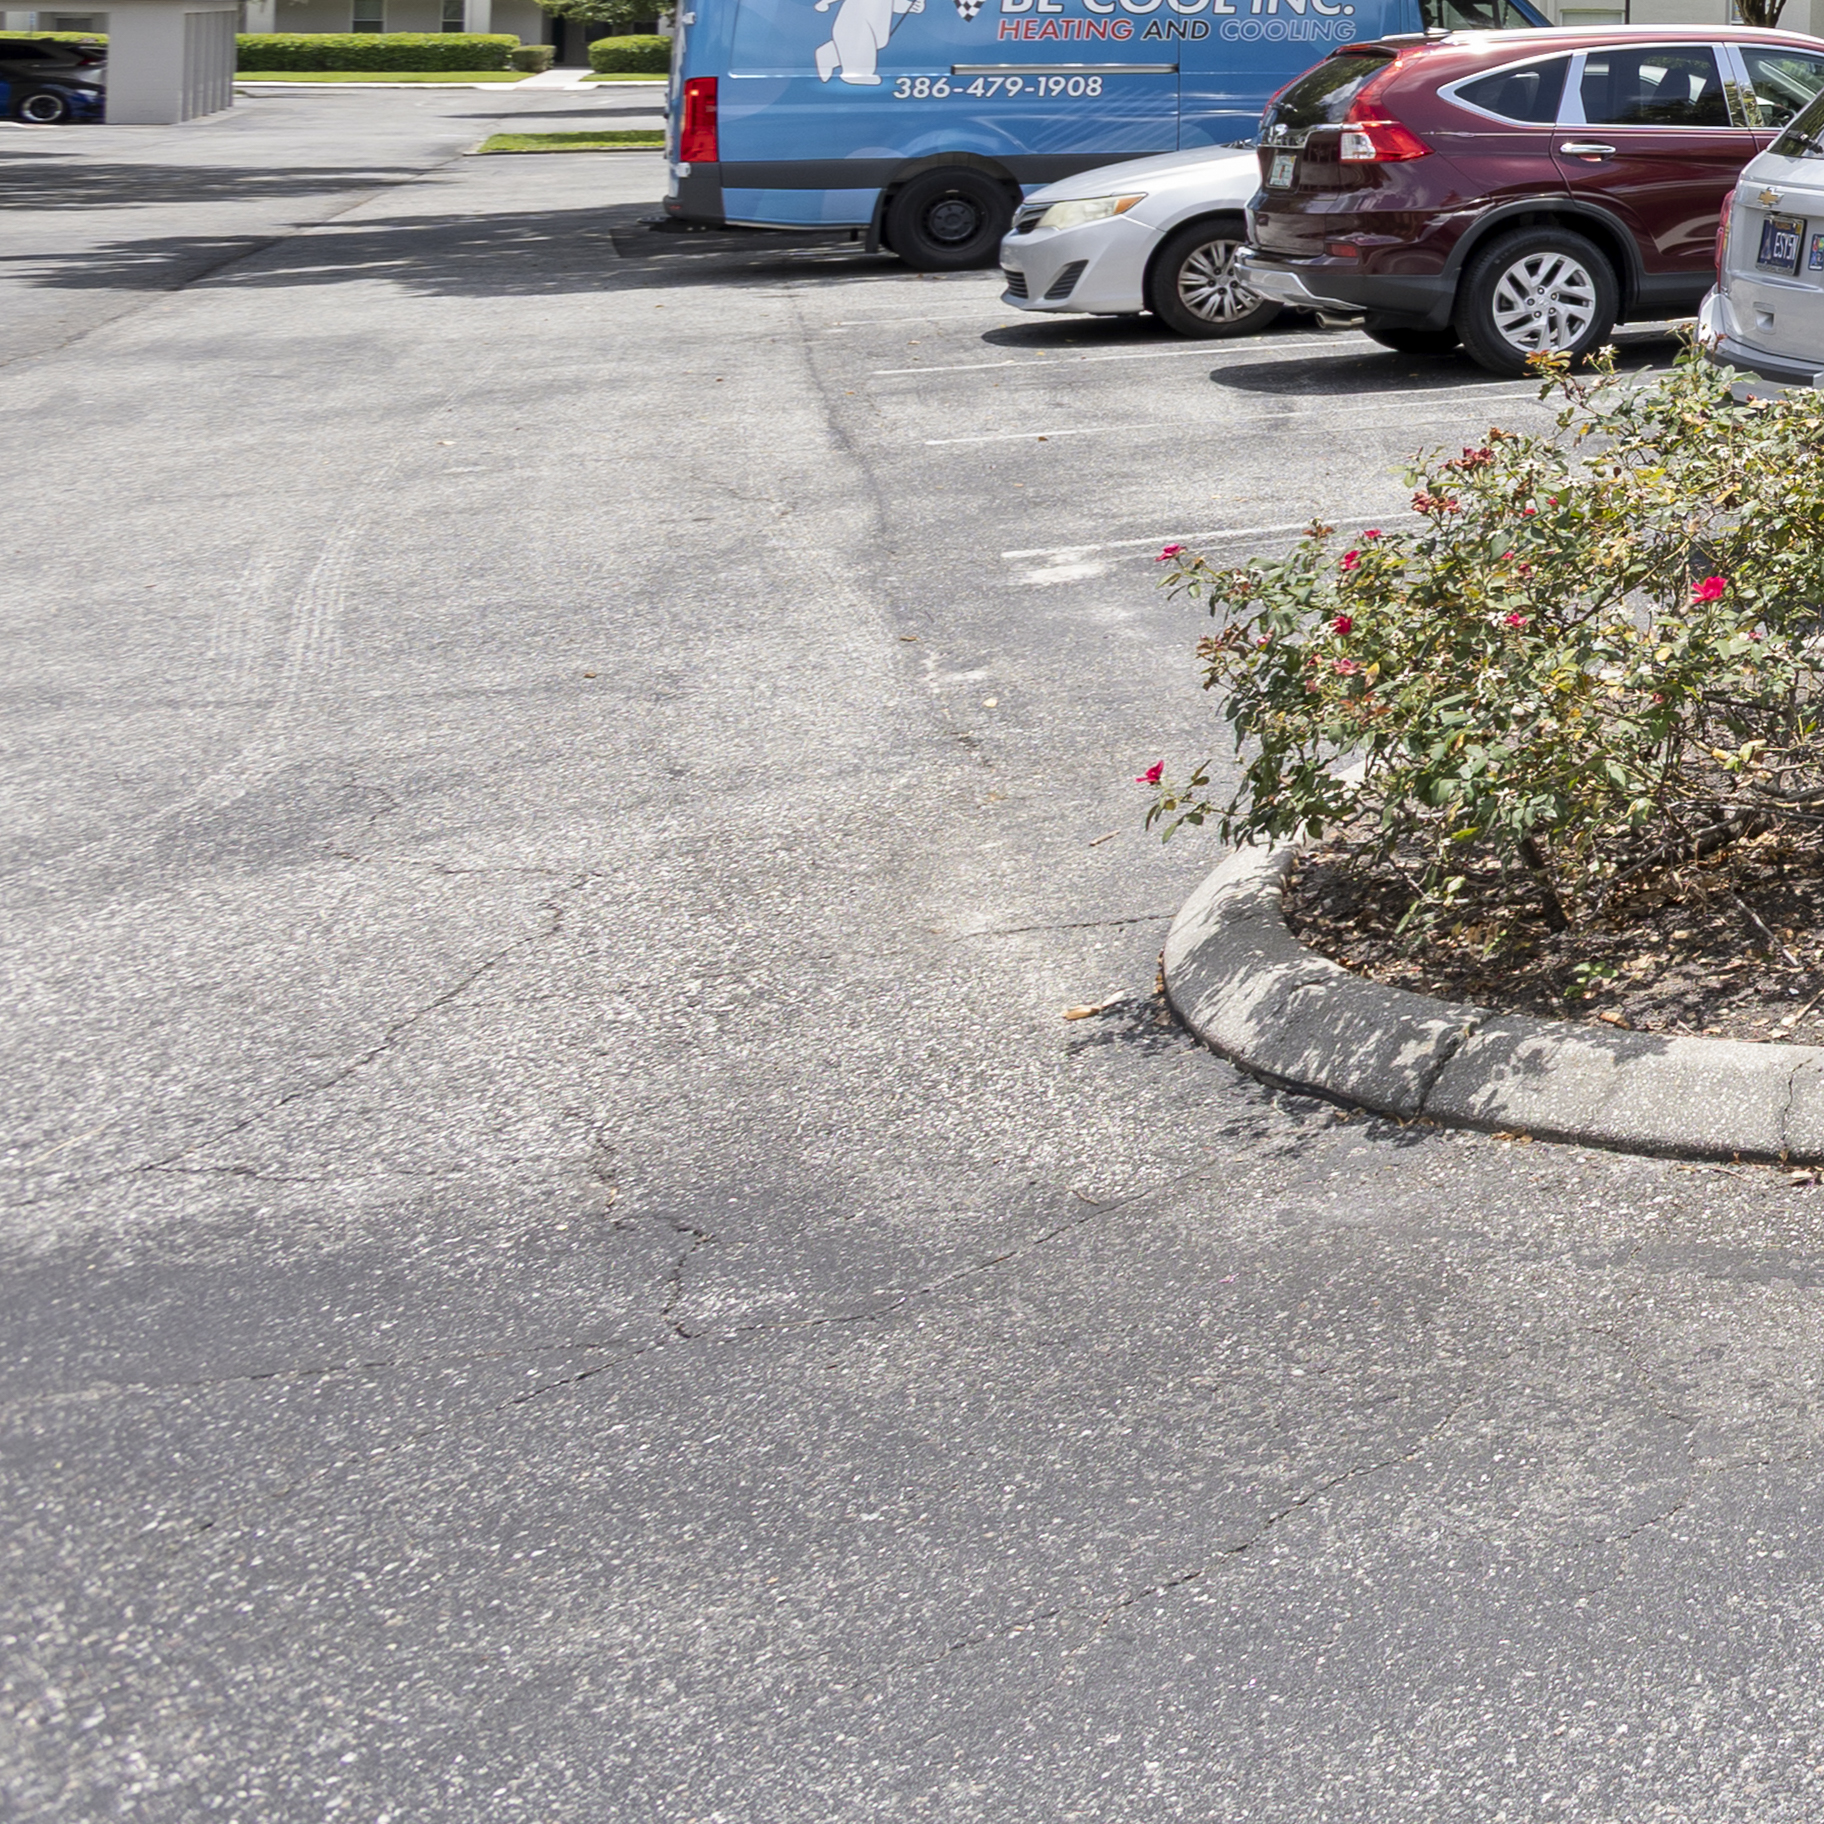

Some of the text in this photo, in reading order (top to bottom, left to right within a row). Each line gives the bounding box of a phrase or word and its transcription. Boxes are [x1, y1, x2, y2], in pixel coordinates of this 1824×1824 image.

[997, 18, 1356, 42] HEATING AND COOLING
[893, 76, 1103, 98] 386-479-1908
